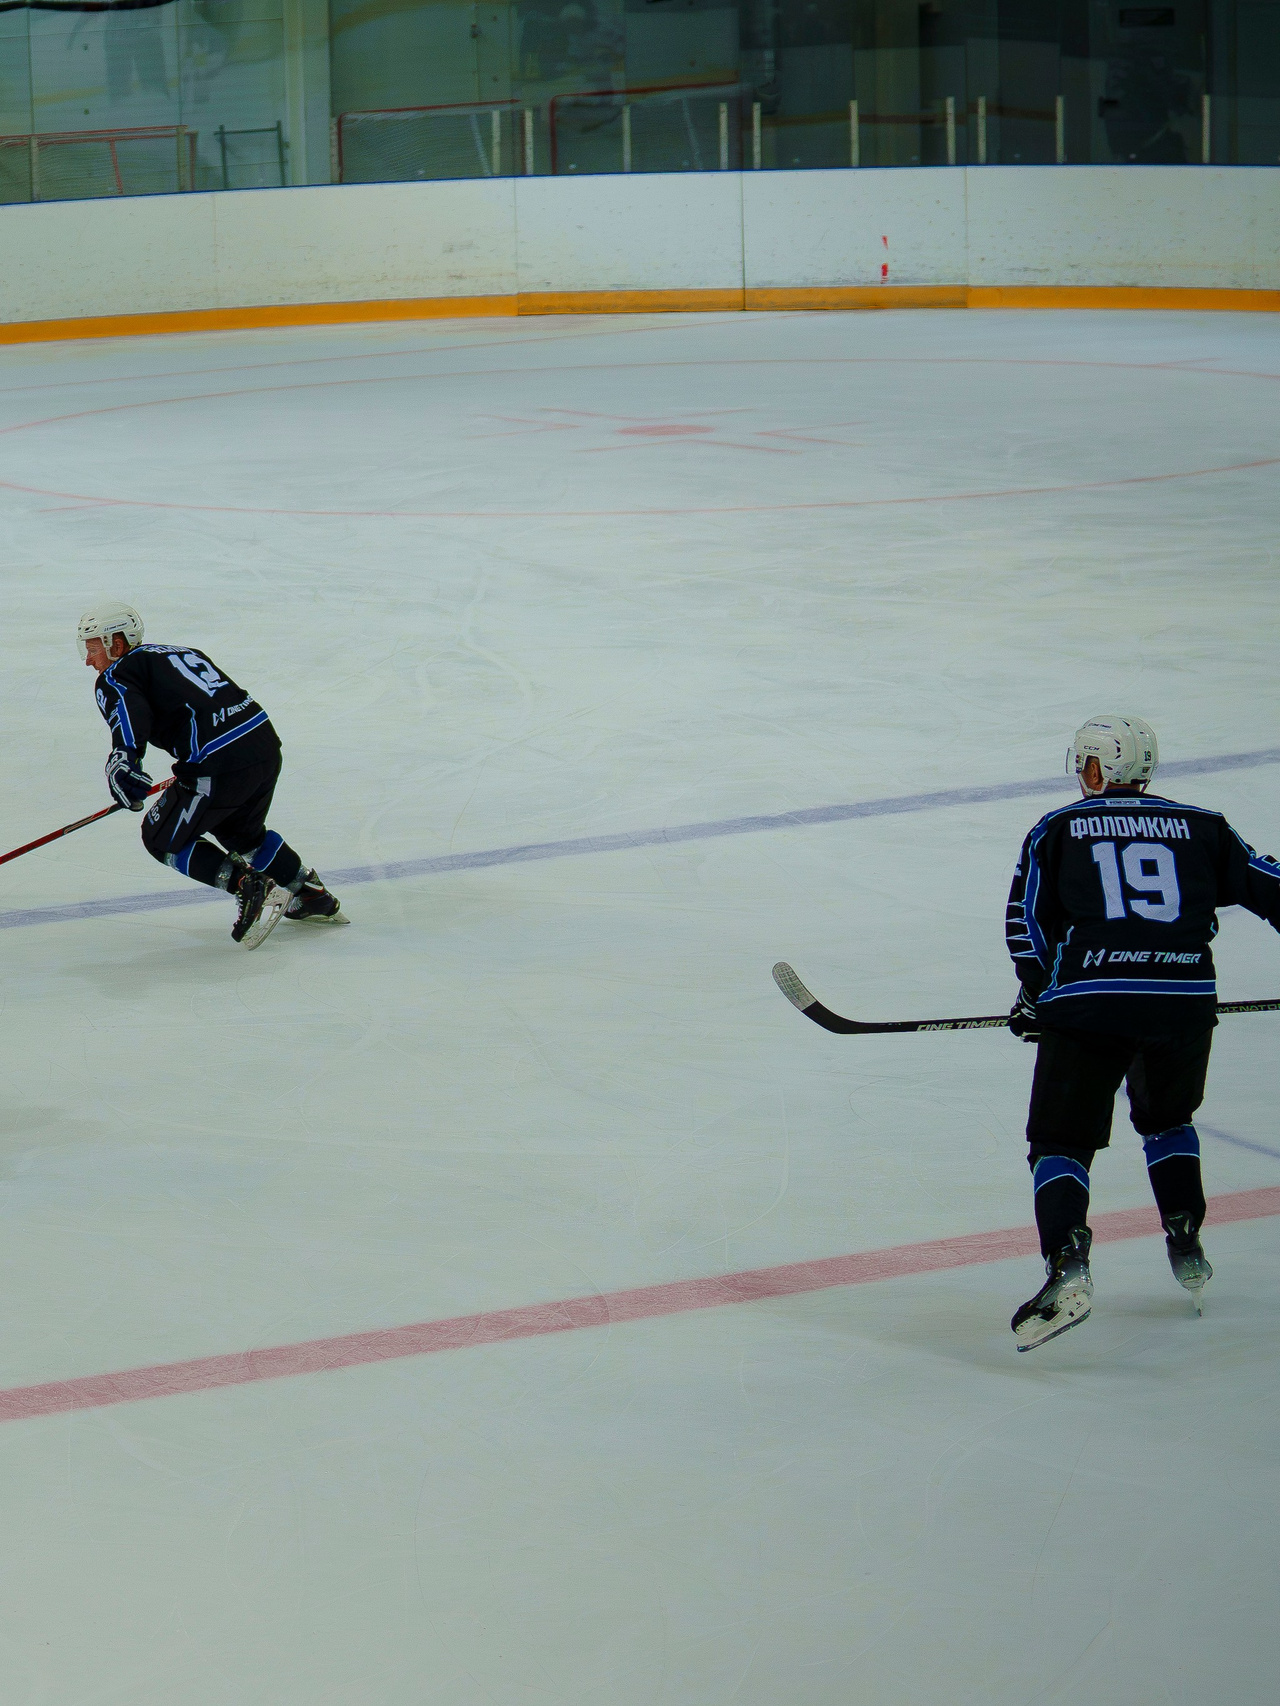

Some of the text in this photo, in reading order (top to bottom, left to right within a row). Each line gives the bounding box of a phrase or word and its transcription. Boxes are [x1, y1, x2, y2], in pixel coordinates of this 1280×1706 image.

[168, 654, 229, 697] 12
[1070, 816, 1191, 839] ФОЛОМКИН
[1092, 841, 1181, 922] 19
[1108, 951, 1202, 964] ONE TIMER
[1215, 1003, 1280, 1013] MINATO
[955, 1018, 1009, 1030] TIMER
